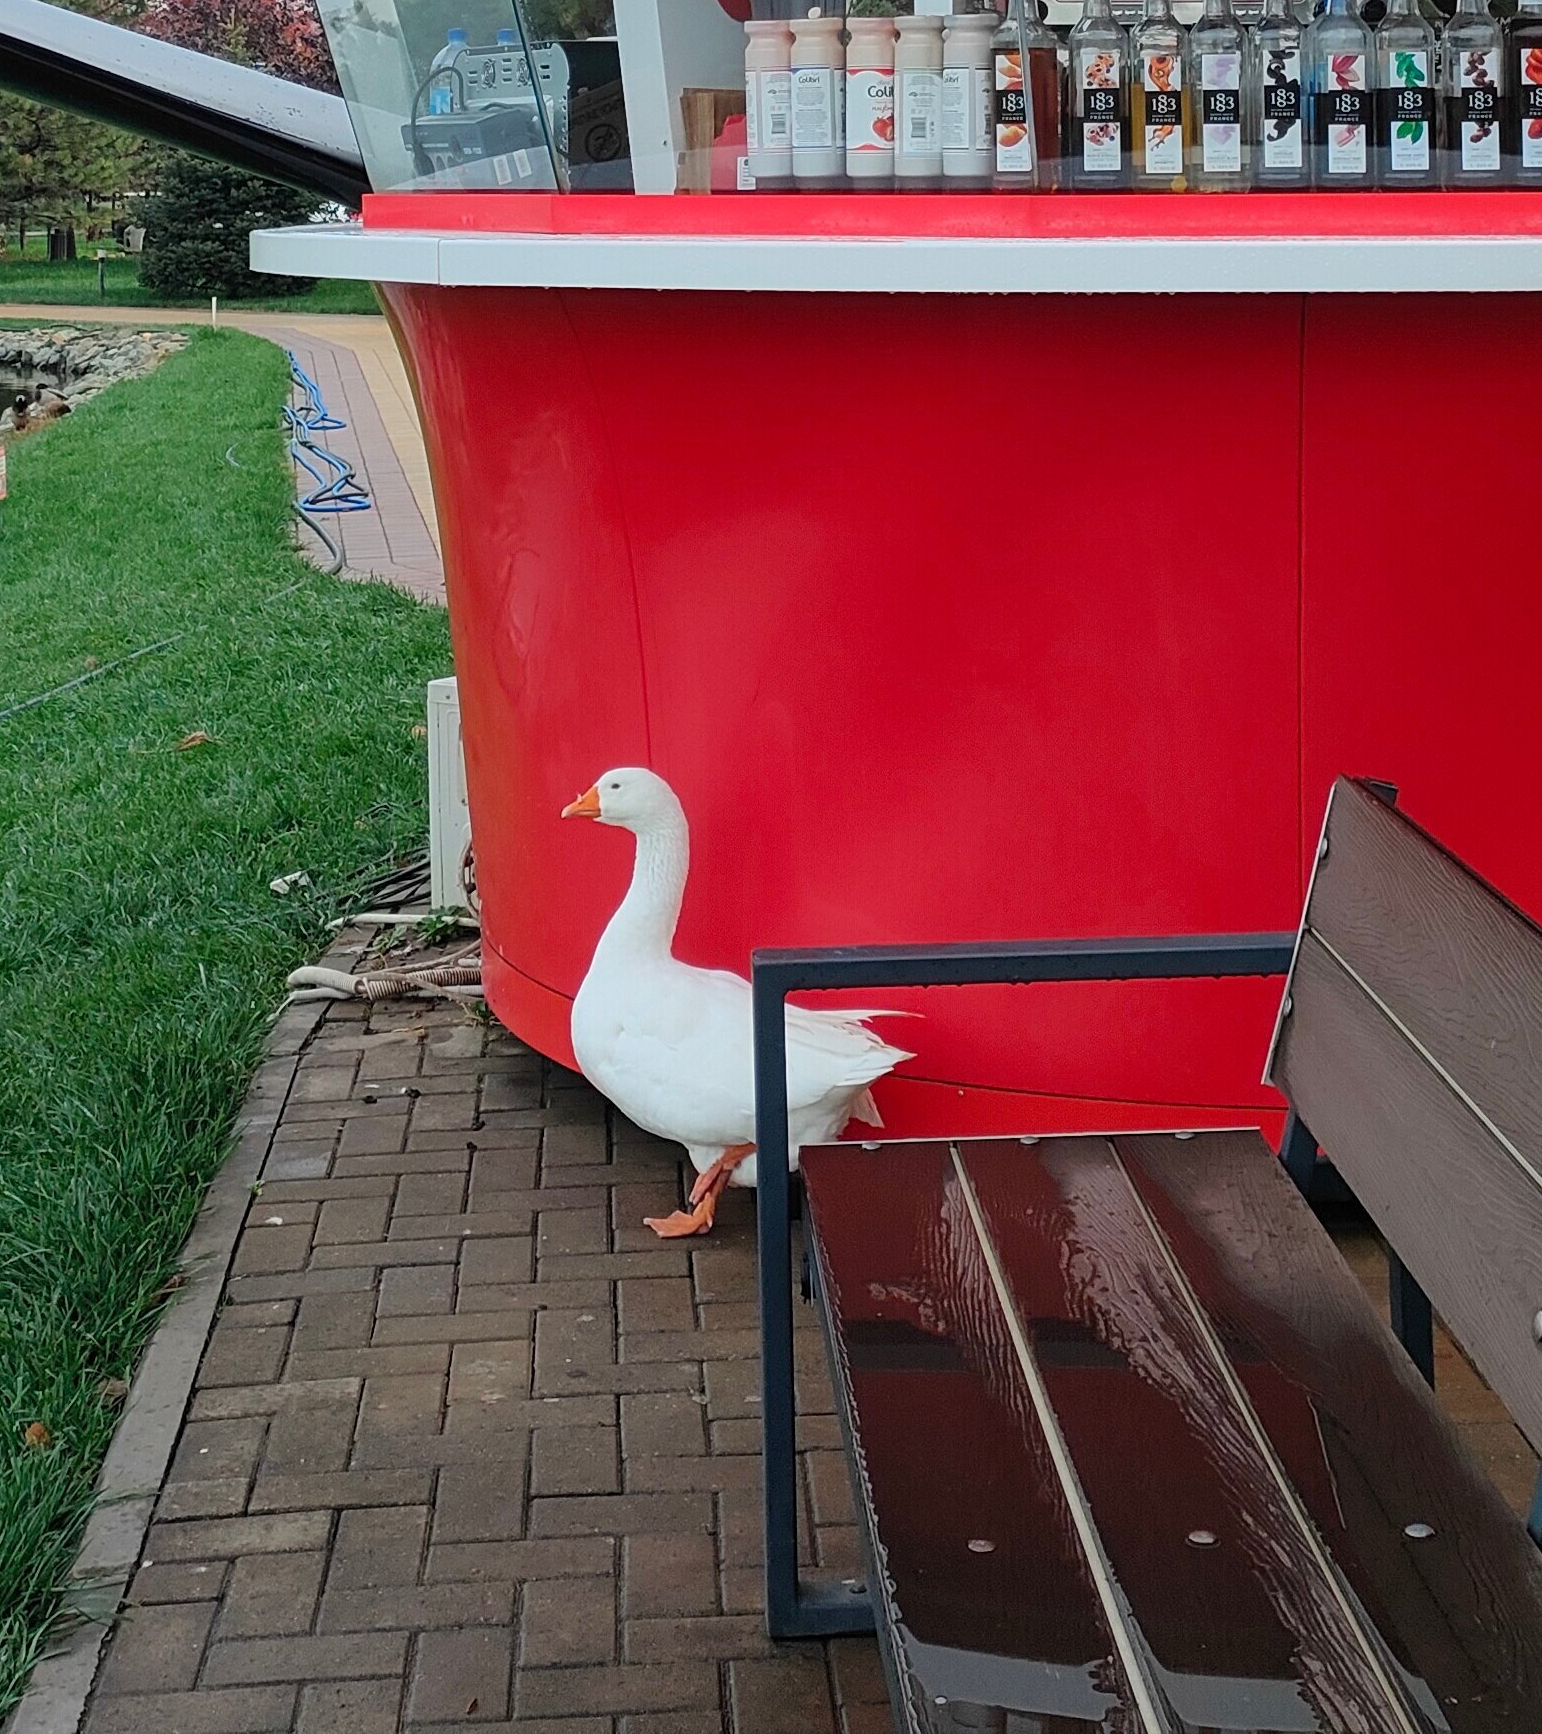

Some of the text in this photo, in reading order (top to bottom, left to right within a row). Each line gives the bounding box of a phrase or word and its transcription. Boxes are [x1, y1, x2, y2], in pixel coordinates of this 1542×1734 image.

[1001, 93, 1024, 112] 1883
[1090, 91, 1115, 111] 1883
[1151, 94, 1177, 114] 1883
[1210, 93, 1235, 112] 1883
[1270, 88, 1296, 108] 1883
[1335, 93, 1360, 113] 1883
[1397, 90, 1423, 110] 1883
[1468, 90, 1493, 110] 1883
